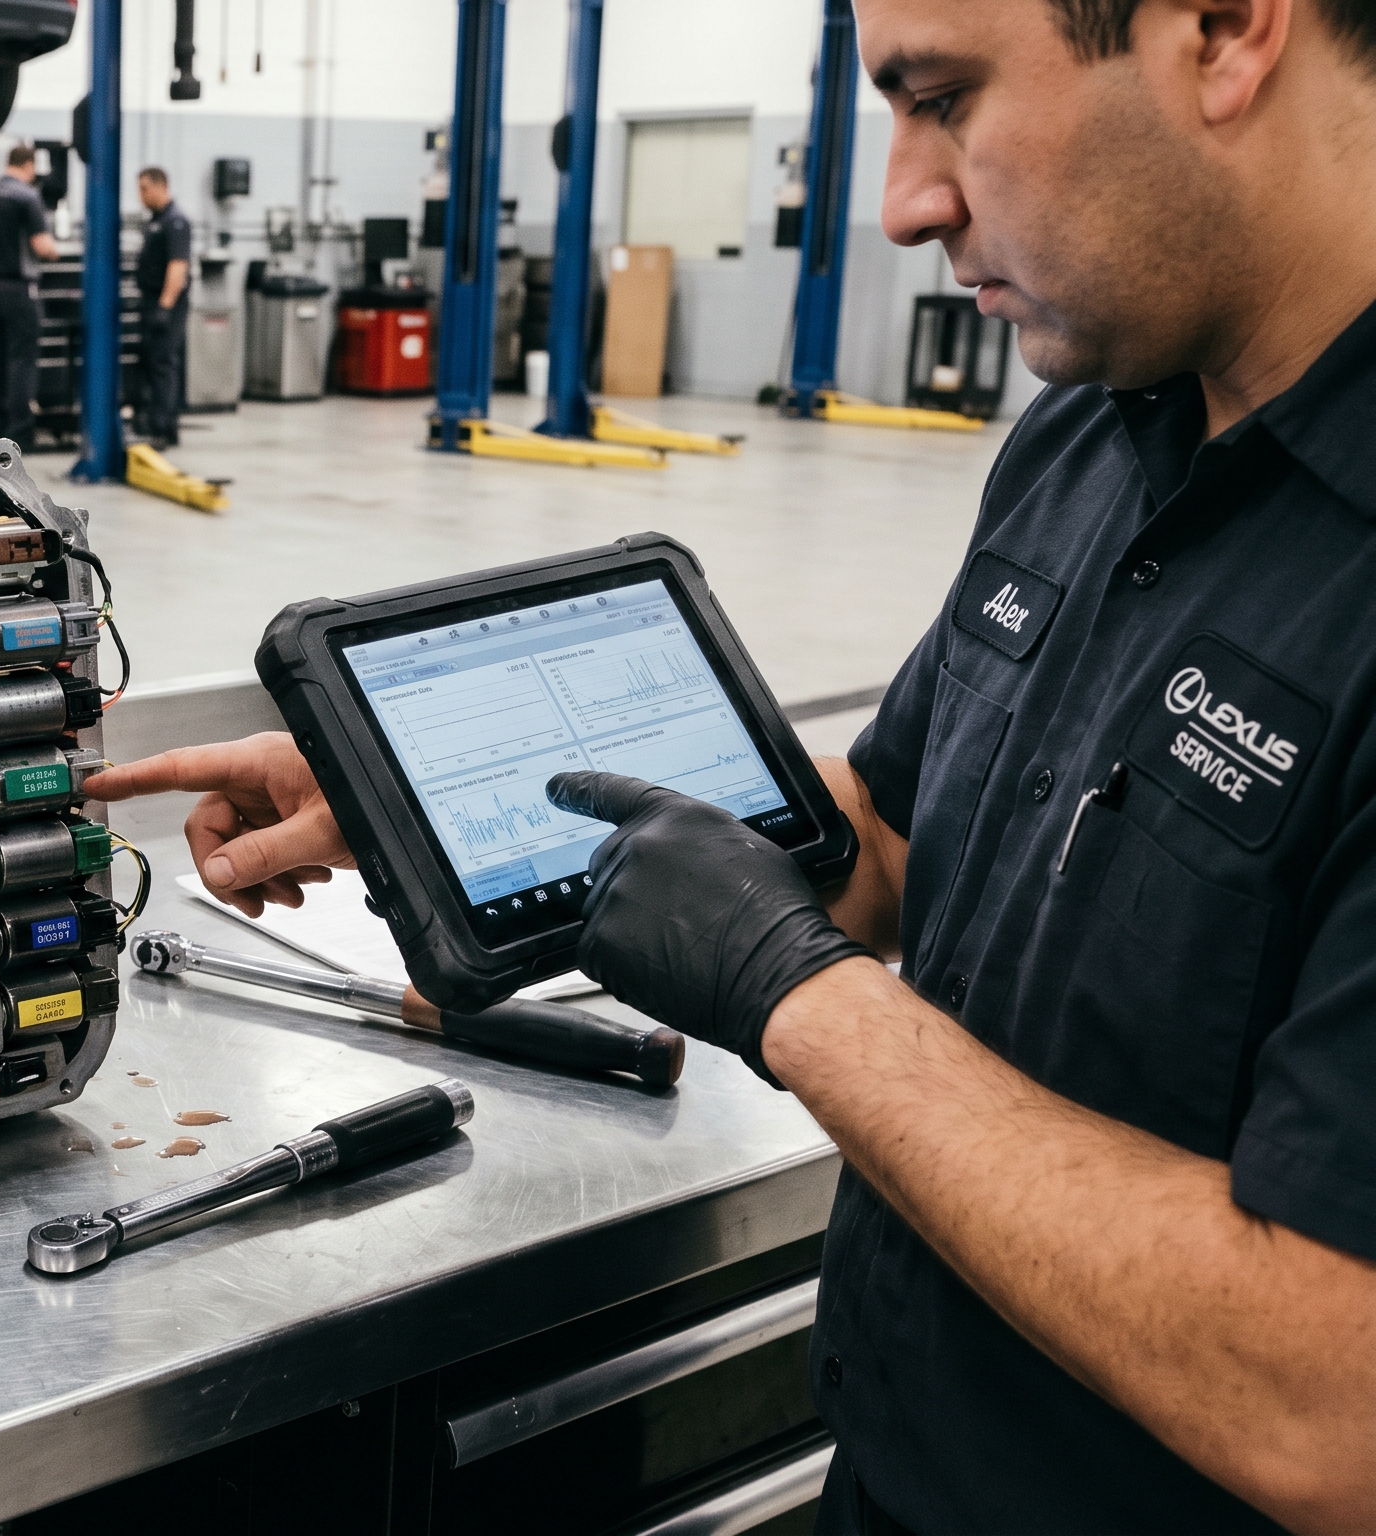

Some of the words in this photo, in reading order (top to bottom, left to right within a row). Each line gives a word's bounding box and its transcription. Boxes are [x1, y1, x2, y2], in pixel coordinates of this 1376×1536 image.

[982, 582, 1029, 633] Alex
[1170, 731, 1253, 803] SERVICE
[1198, 691, 1299, 771] LEXUS
